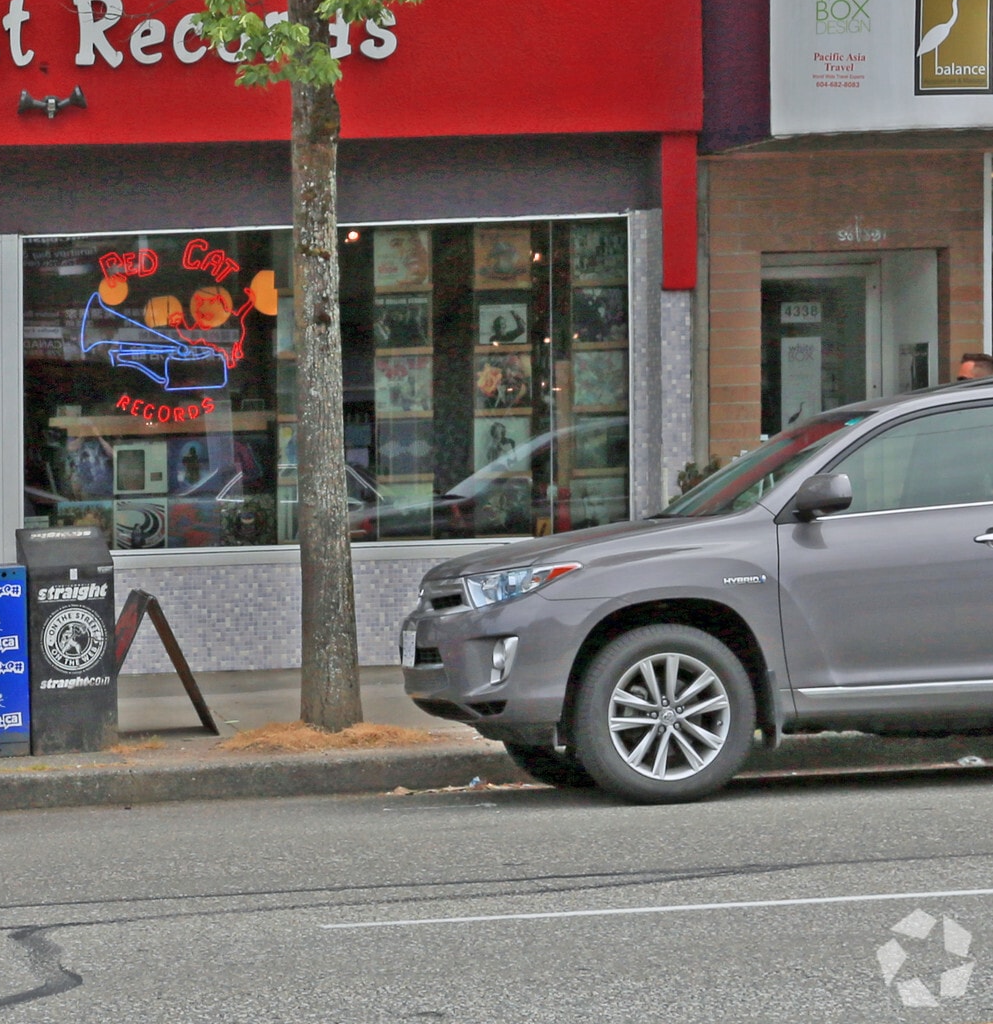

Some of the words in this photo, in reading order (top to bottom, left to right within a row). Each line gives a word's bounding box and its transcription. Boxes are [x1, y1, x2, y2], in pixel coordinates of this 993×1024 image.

[816, 0, 870, 21] BOX
[816, 20, 871, 35] DESIGN
[813, 52, 844, 62] Pacific
[846, 52, 866, 62] Asia
[824, 62, 854, 72] Travel
[935, 62, 986, 76] balance
[99, 248, 158, 288] RED
[182, 238, 240, 283] CAT
[116, 394, 215, 423] RECORDS
[723, 576, 759, 584] HYBRID
[38, 582, 108, 601] straight
[49, 624, 58, 636] ON
[58, 613, 72, 624] THE
[51, 648, 63, 661] ON
[64, 658, 80, 666] THE
